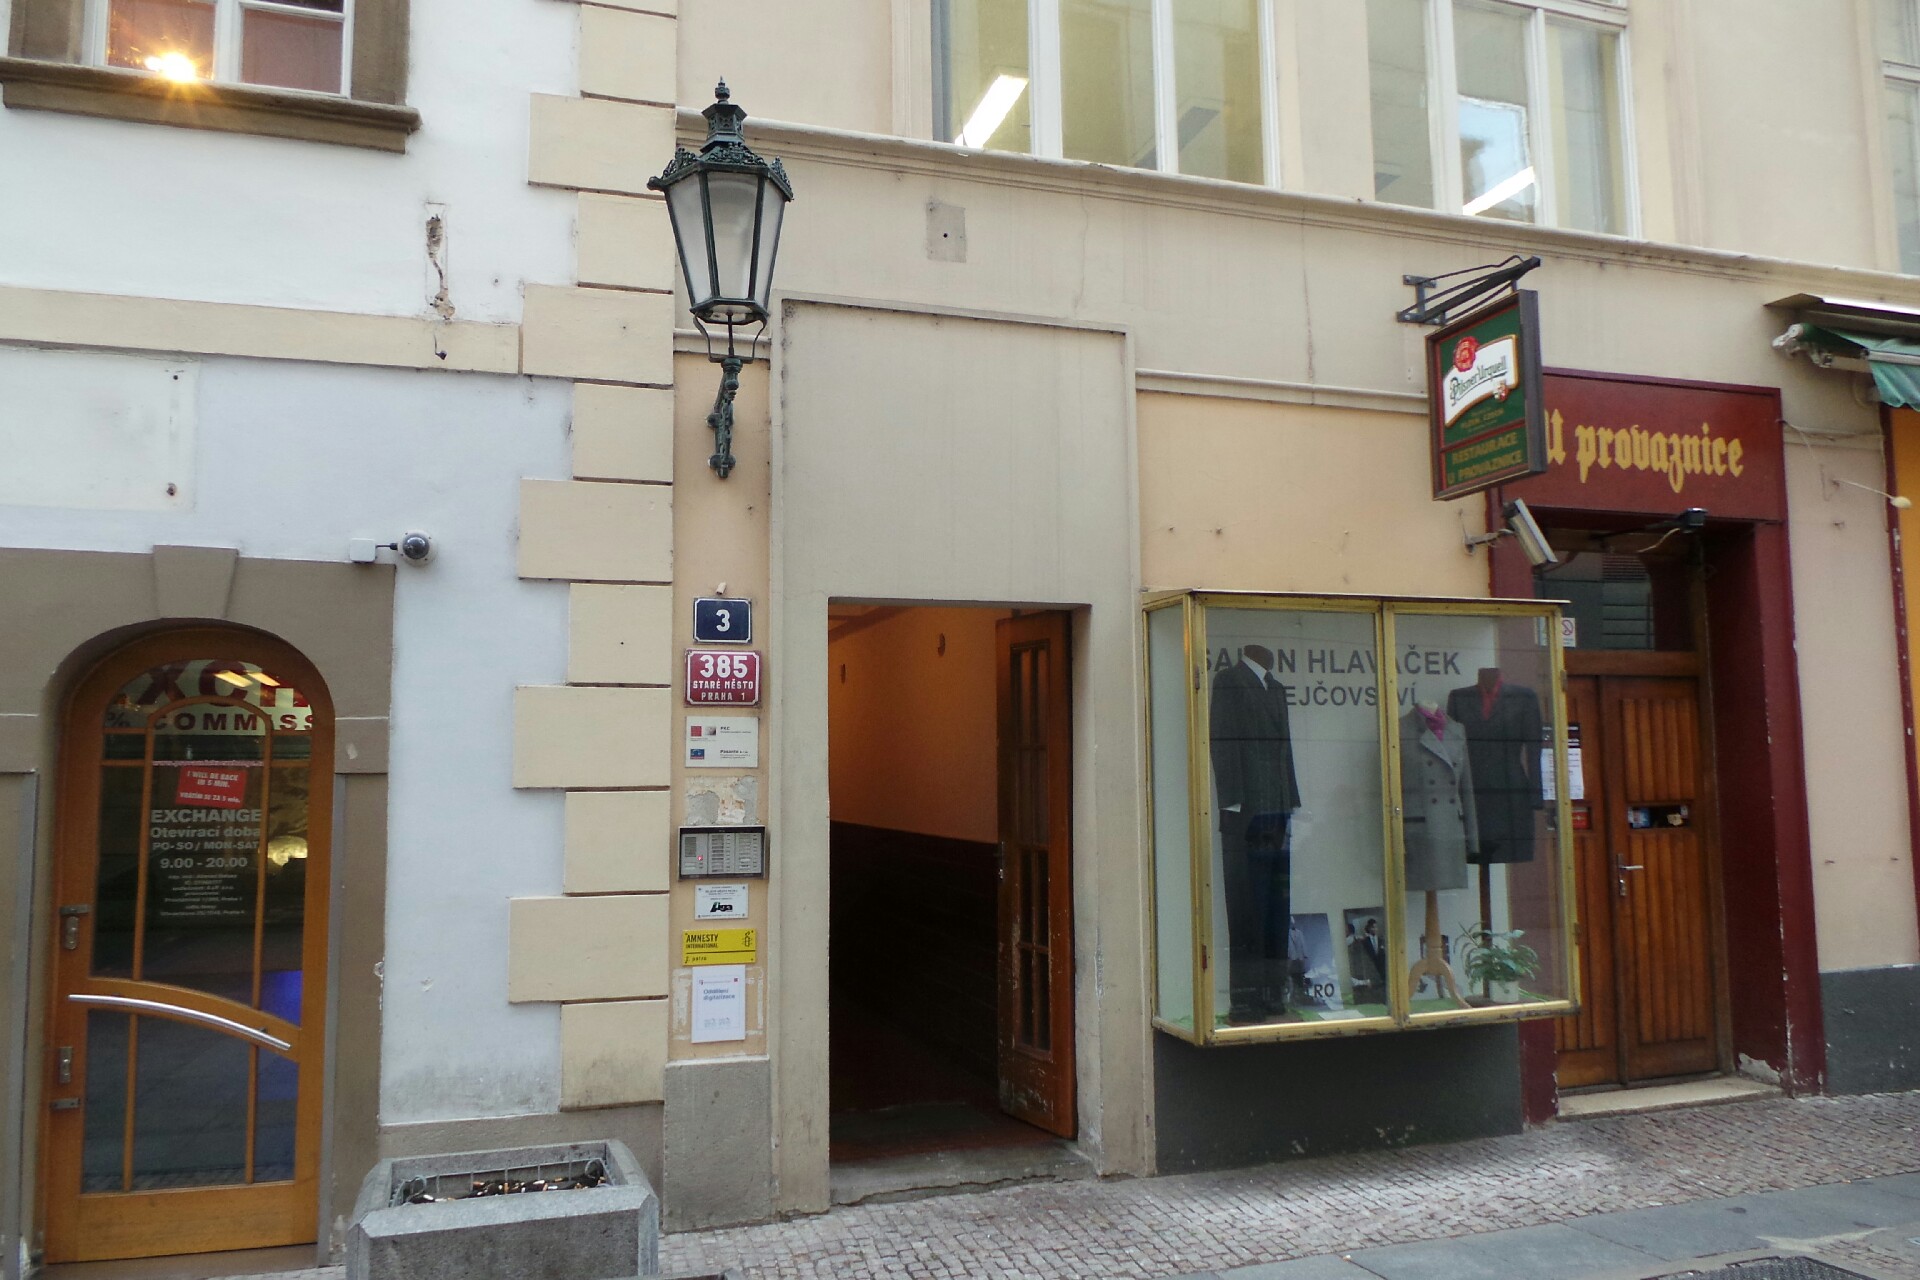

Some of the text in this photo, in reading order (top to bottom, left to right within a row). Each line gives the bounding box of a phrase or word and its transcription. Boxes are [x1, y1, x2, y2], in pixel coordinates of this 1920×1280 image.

[1452, 432, 1518, 464] RESTAURACE
[1544, 408, 1744, 493] U provaznice
[1458, 450, 1522, 481] PROVAZNICE
[716, 609, 731, 632] 3
[1308, 645, 1461, 675] HLAVČEK
[700, 655, 748, 678] 385
[692, 678, 754, 690] STARÉ MĚSTO
[701, 692, 745, 701] PRAHA 1
[220, 773, 238, 781] BACK
[151, 809, 262, 822] EXCHANGE
[223, 826, 261, 837] doba
[152, 842, 194, 851] PO-SO
[203, 841, 260, 850] MON-SAT
[160, 858, 194, 868] 9.00
[206, 857, 248, 867] 20.00
[686, 934, 718, 942] AMNESTY
